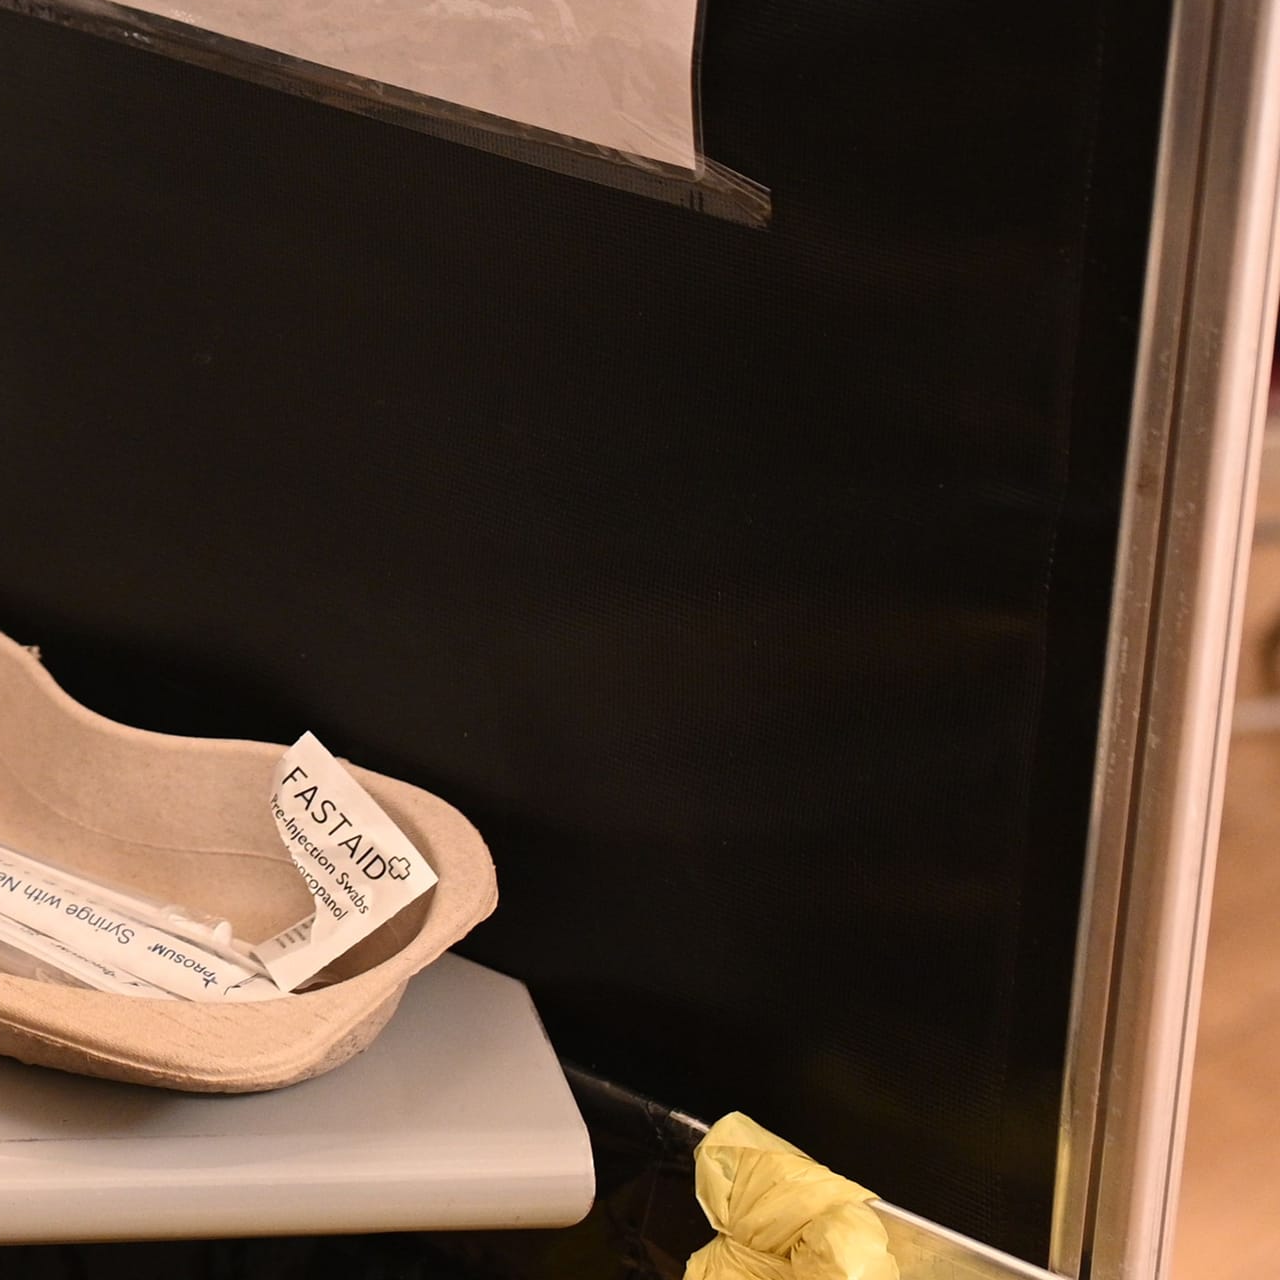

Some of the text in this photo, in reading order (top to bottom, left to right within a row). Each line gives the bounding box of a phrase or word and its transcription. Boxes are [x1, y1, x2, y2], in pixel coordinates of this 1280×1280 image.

[281, 766, 389, 882] FASTAID
[22, 882, 63, 910] with
[335, 872, 370, 915] Swabs
[65, 902, 136, 945] Syringe
